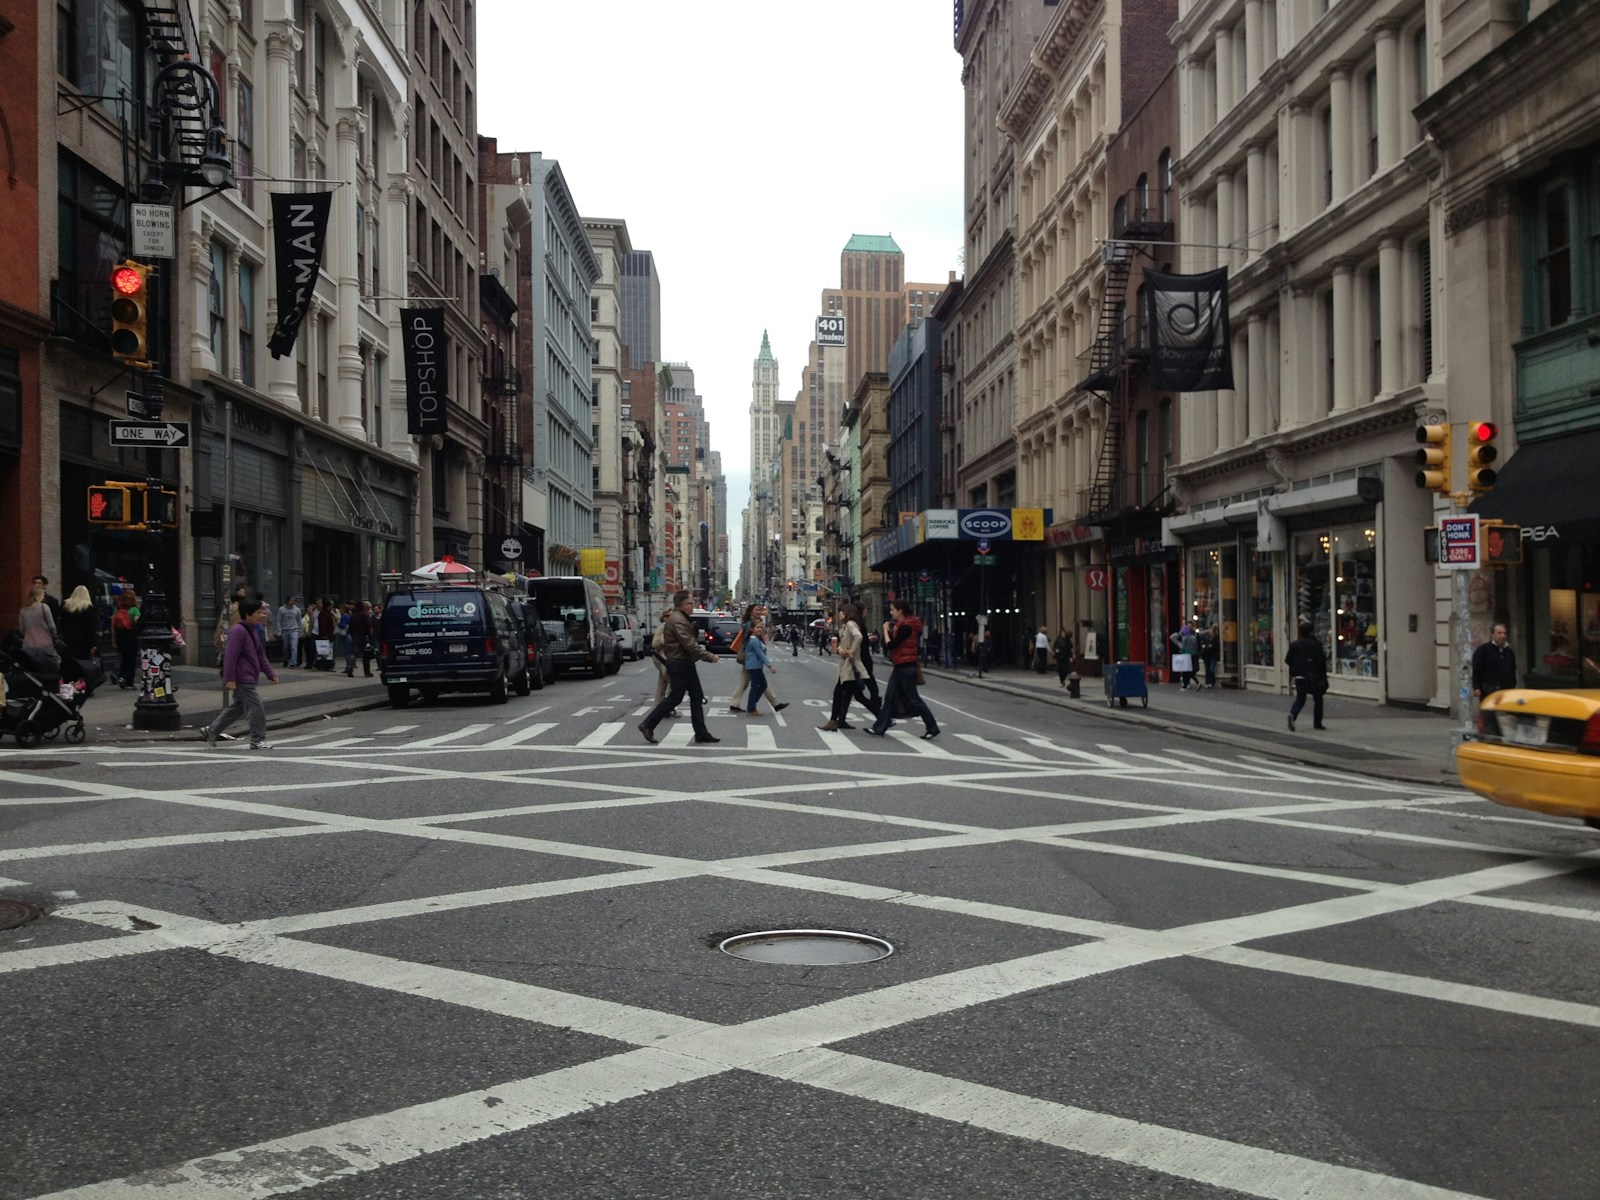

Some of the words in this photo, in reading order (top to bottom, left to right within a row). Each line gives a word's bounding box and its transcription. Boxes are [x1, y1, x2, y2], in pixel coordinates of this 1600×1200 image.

[136, 209, 147, 217] NO
[150, 210, 170, 218] HORN
[136, 219, 170, 229] BLOWING
[819, 319, 843, 331] 401
[819, 331, 844, 344] Broadway
[413, 317, 438, 428] TOPSHOP
[122, 428, 144, 439] ONE
[154, 429, 177, 439] WAY
[966, 520, 1006, 528] SCOOP
[1446, 523, 1471, 532] DON'T
[1447, 531, 1471, 540] HONK
[408, 600, 462, 619] donnelly
